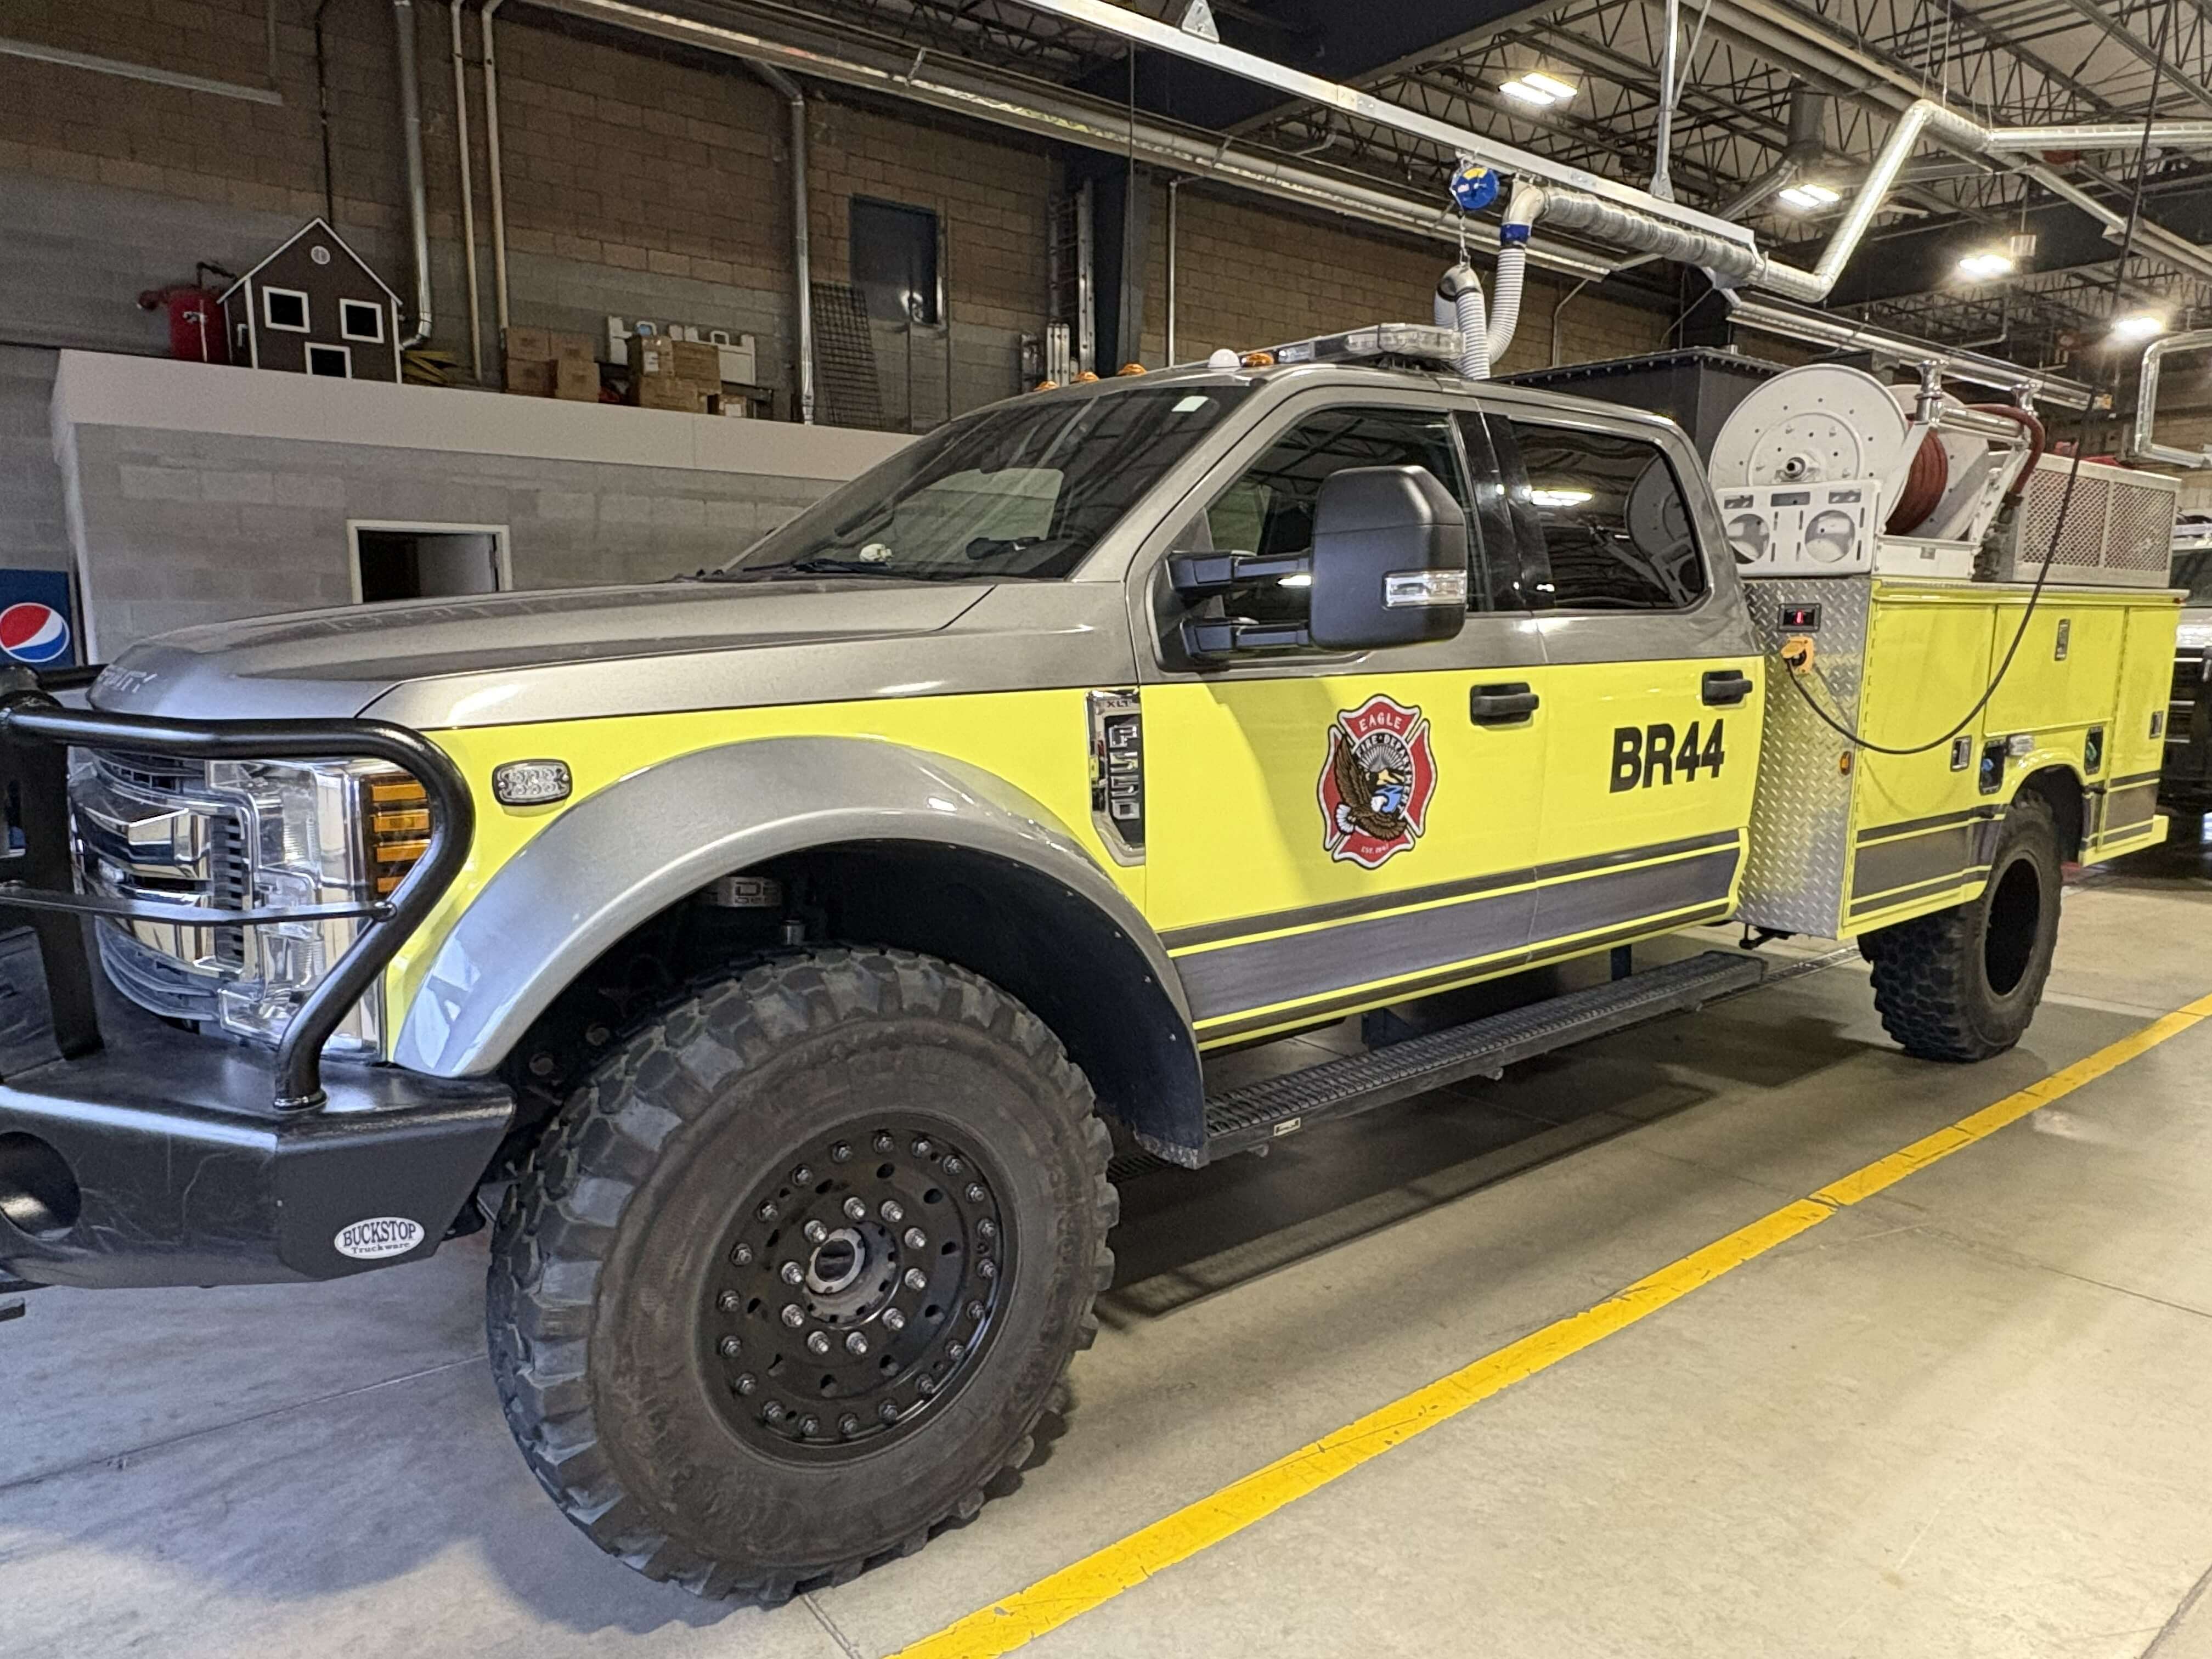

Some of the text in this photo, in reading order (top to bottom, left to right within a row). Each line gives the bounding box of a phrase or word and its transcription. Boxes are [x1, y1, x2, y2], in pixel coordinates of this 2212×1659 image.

[1107, 700, 1128, 708] XLT
[1358, 712, 1403, 732] EAGLE
[1609, 718, 1725, 794] BR44
[1356, 733, 1413, 814] FIRE DEPARTMENT
[343, 1220, 416, 1247] BUCKSTOP
